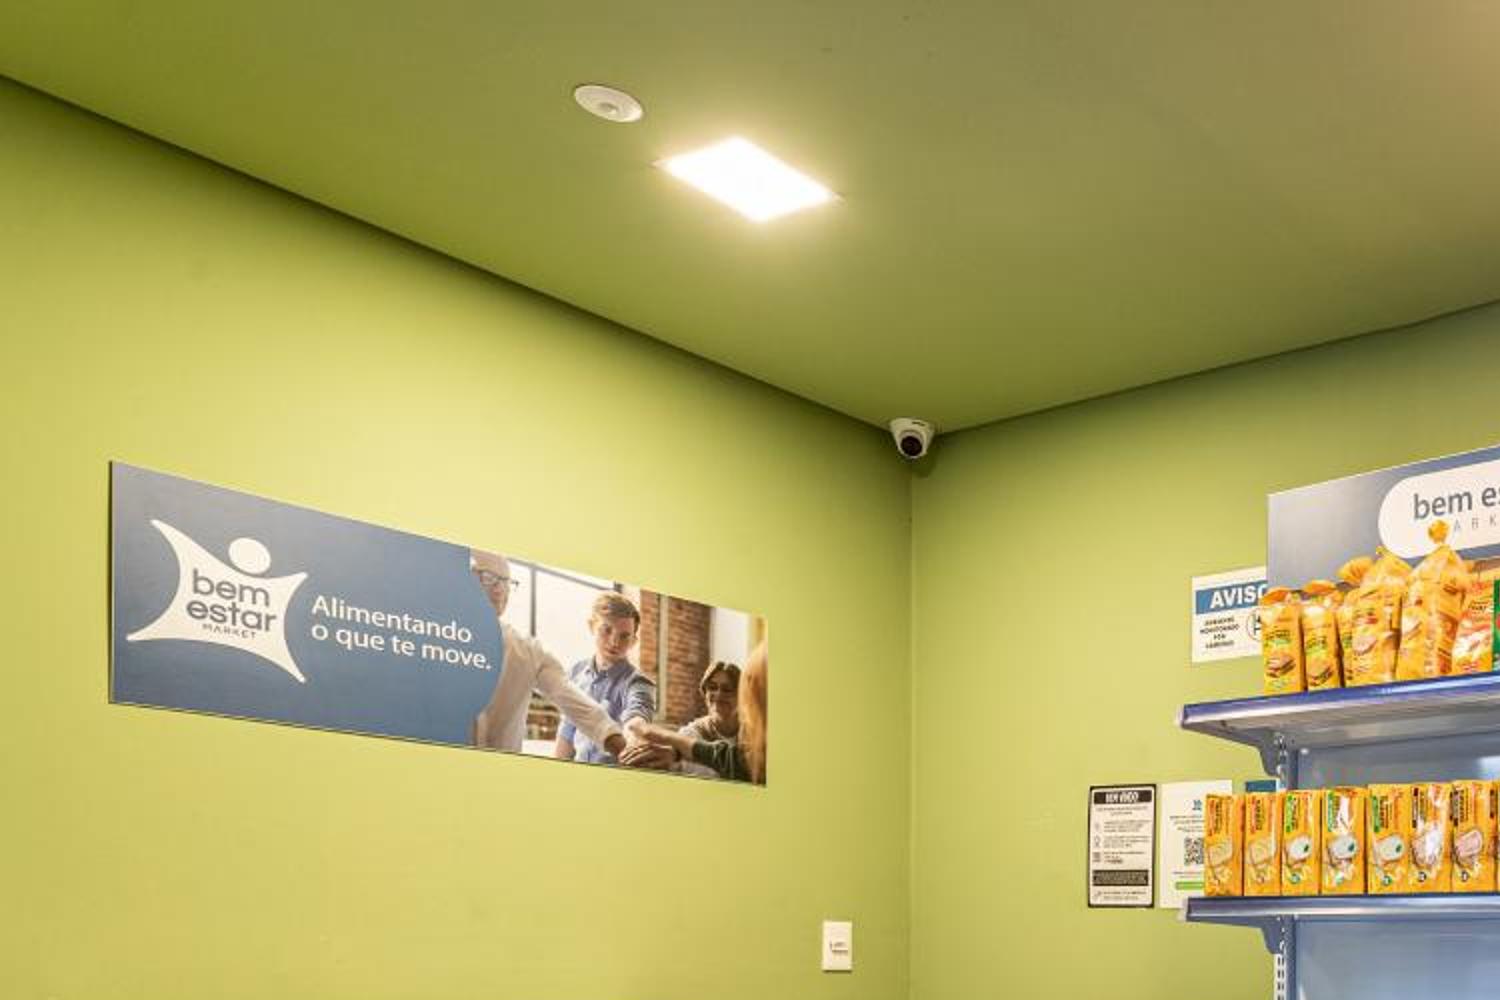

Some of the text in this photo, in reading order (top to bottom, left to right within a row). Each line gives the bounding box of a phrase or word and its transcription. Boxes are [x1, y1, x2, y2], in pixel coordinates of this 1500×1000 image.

[1413, 493, 1473, 520] bem
[193, 568, 270, 607] bem
[186, 601, 277, 631] estar
[202, 623, 257, 639] MARKET
[311, 595, 472, 643] Alimentando
[311, 624, 492, 669] o que te move.
